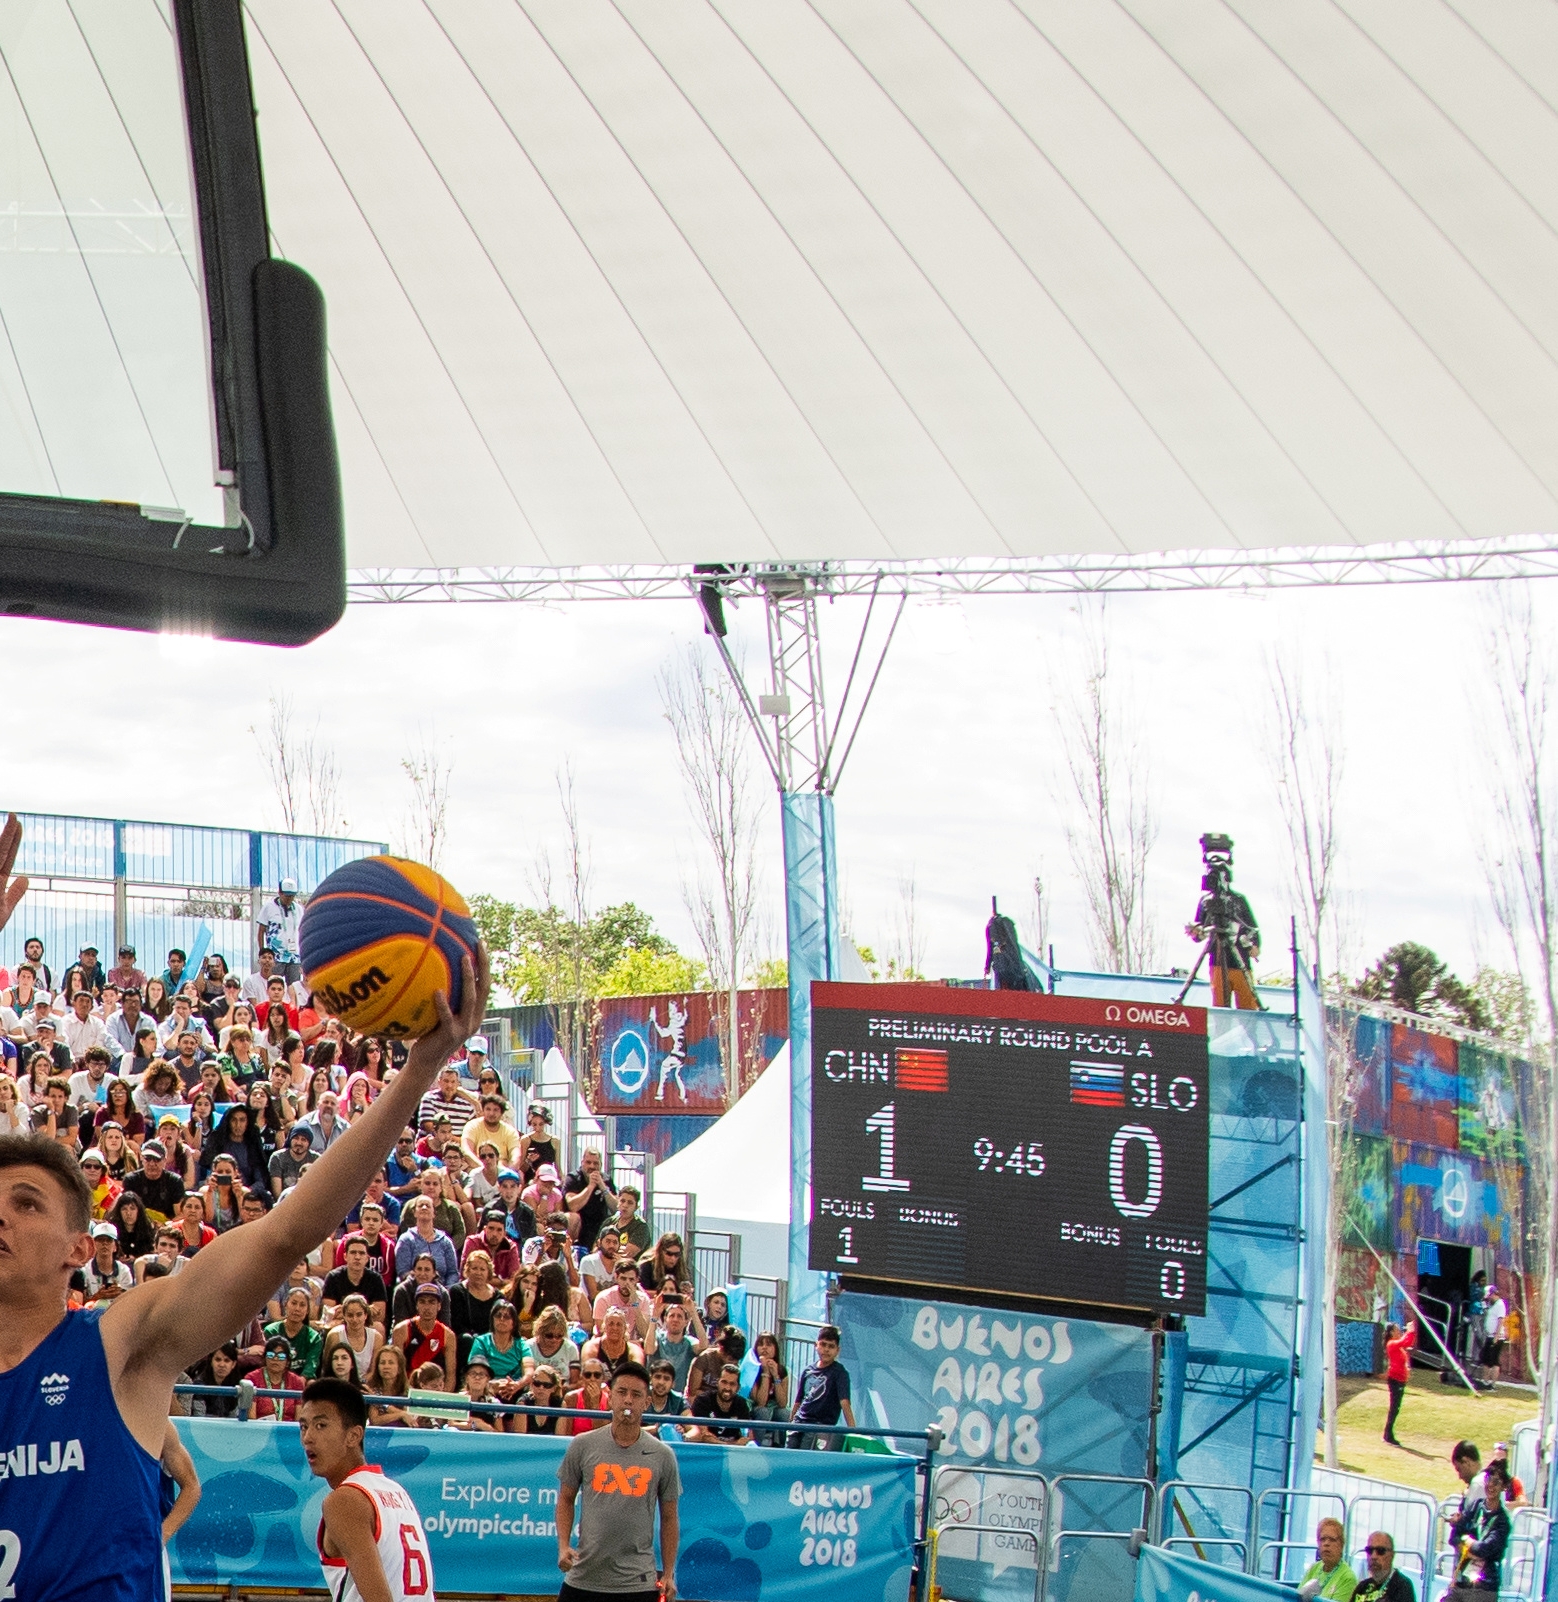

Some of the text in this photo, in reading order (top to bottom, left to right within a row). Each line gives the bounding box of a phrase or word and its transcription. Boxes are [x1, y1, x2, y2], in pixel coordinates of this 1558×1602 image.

[1126, 1007, 1191, 1028] OMEGA
[868, 1018, 1154, 1057] PRELIMINARY ROUND POOL A
[824, 1049, 1199, 1113] CHN SLO
[861, 1100, 911, 1193] 1
[972, 1137, 1047, 1177] 9:45
[1108, 1122, 1164, 1219] 0
[820, 1198, 876, 1221] FOULS
[836, 1226, 859, 1265] 1
[1059, 1223, 1121, 1247] BONUS
[1159, 1260, 1186, 1300] 0
[910, 1305, 1074, 1365] BUENOS
[932, 1356, 1045, 1411] AIRES
[935, 1405, 1042, 1466] 2018
[441, 1477, 531, 1511] Explore
[788, 1480, 873, 1510] BUENOS
[800, 1509, 859, 1537] AIRES
[399, 1522, 429, 1596] 6
[798, 1537, 857, 1568] 2018
